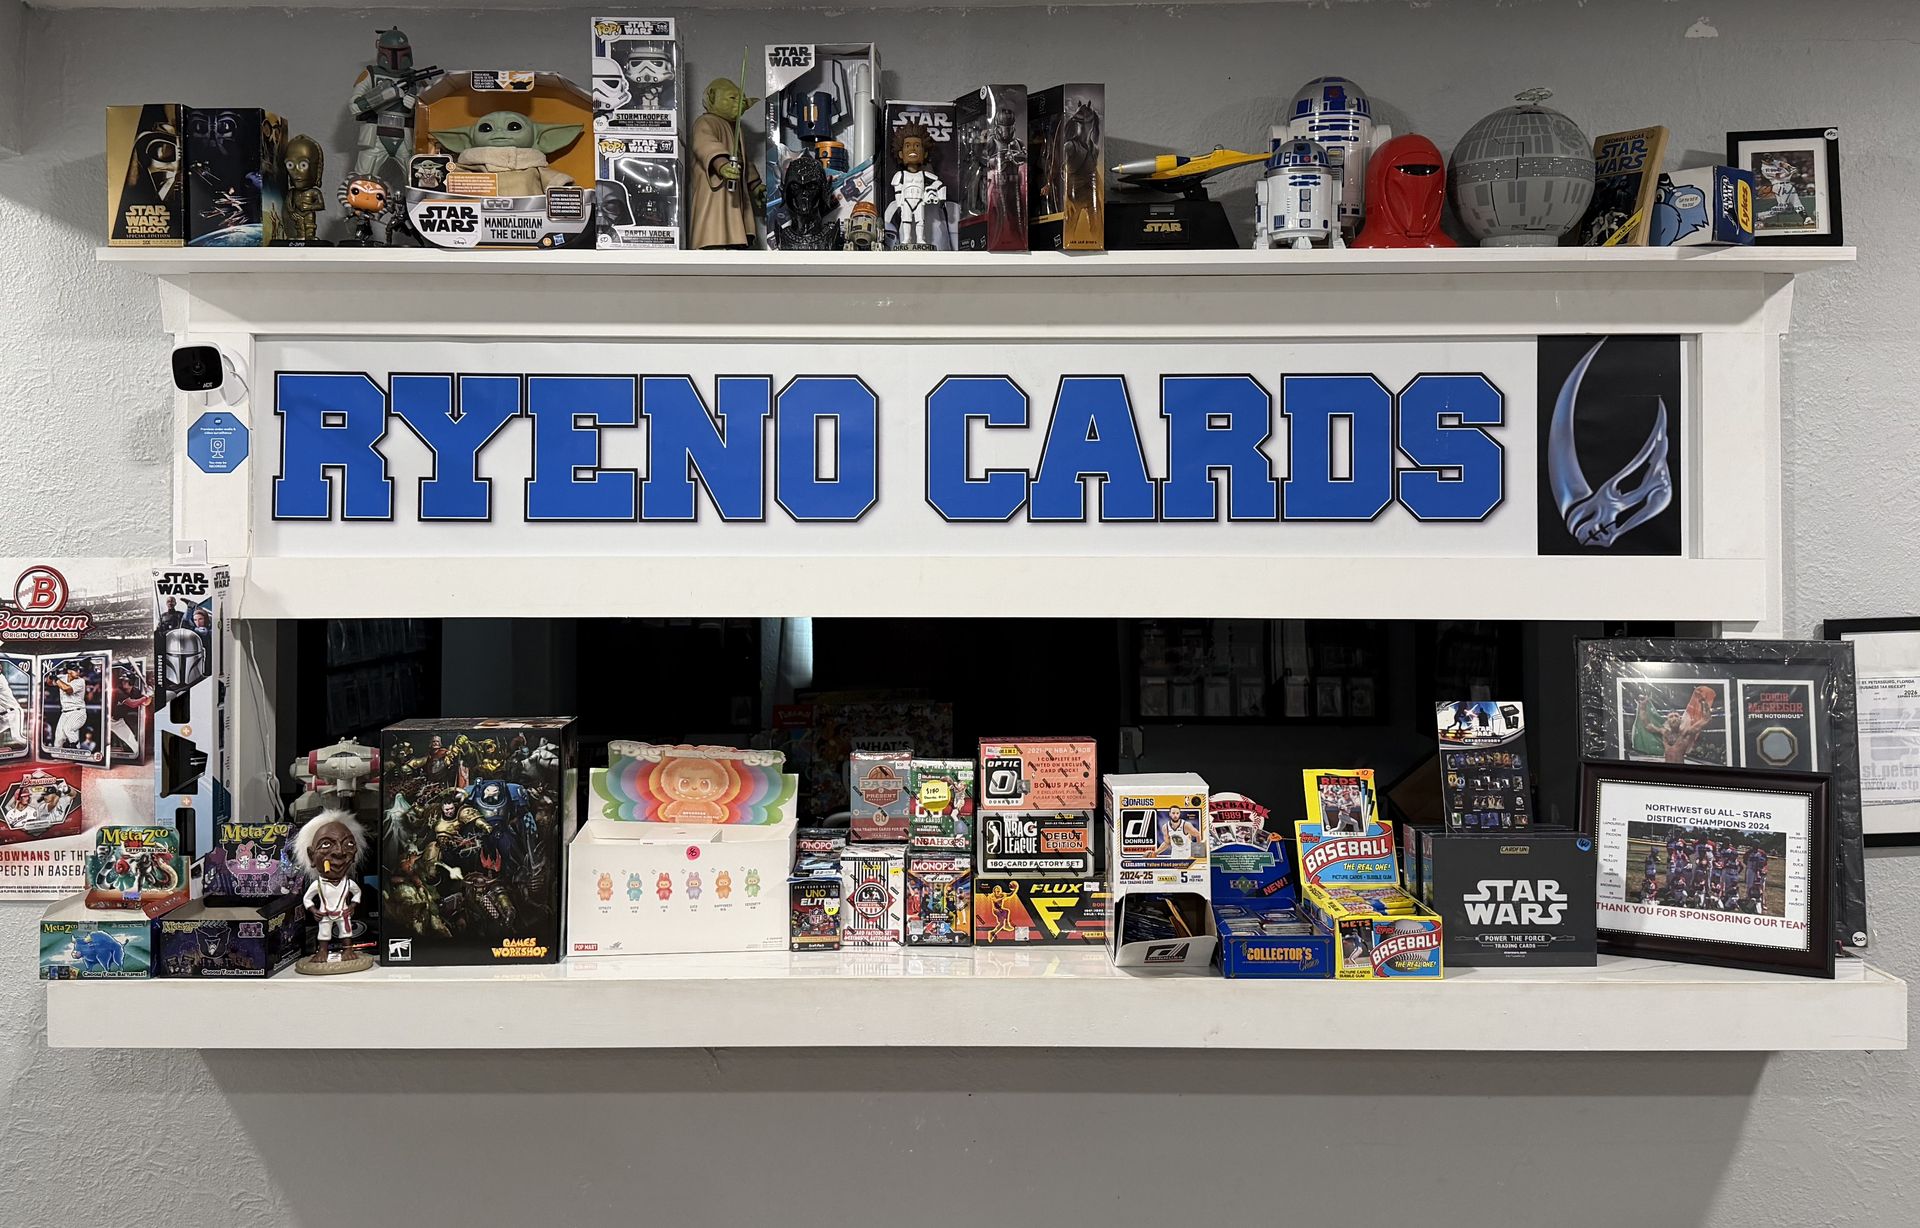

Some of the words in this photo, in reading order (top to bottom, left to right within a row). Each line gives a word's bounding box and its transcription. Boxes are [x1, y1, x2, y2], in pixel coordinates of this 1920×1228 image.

[768, 47, 811, 56] STAR
[769, 57, 812, 66] WARS
[892, 112, 952, 126] STAR
[1602, 139, 1648, 160] STAR
[1595, 154, 1646, 174] WARS
[125, 205, 170, 216] STAR
[419, 206, 478, 219] STAR
[1740, 186, 1750, 227] Lykes
[125, 216, 170, 226] WARS
[419, 220, 478, 232] WARS
[484, 218, 542, 229] MANDALORIAN
[1143, 222, 1182, 232] STAR
[490, 230, 506, 239] THE
[510, 230, 536, 239] CHILD
[272, 371, 880, 522] RYENO
[924, 372, 1505, 524] CARDS
[157, 573, 208, 583] STAR
[214, 571, 230, 580] STAR
[158, 584, 208, 595] WARS
[214, 580, 230, 589] WARS
[0, 610, 88, 630] Bowman
[1760, 693, 1789, 701] CONOR
[1748, 702, 1803, 712] McGREGOR
[1645, 804, 1702, 814] NORTHWEST
[1647, 815, 1687, 824] DISTRICT
[1690, 817, 1746, 828] CHAMPIONS
[222, 824, 289, 843] MetaZoo
[1005, 821, 1023, 837] NBA
[1024, 821, 1037, 837] G
[102, 828, 168, 846] MetaZoo
[1005, 838, 1037, 854] LEAGUE
[0, 850, 50, 862] BOWMANS
[55, 851, 66, 861] OF
[1306, 839, 1388, 873] BASEBALL
[34, 866, 43, 876] IN
[49, 866, 86, 876] BASEBA
[1120, 871, 1153, 880] 2024-25
[1181, 871, 1188, 883] 5
[1030, 884, 1082, 893] FLUX
[1263, 877, 1288, 895] NEW!
[1464, 880, 1567, 901] STAR
[1464, 903, 1567, 925] WARS
[1596, 902, 1629, 913] THANK
[1632, 906, 1654, 916] YOU
[1657, 907, 1676, 917] FOR
[1680, 910, 1750, 924] SPONSORING
[1754, 918, 1777, 927] OUR
[1780, 920, 1807, 930] TEAM
[44, 924, 78, 934] MetaZoo
[503, 938, 536, 947] GAMES
[491, 947, 547, 957] WORKSHOP
[1247, 947, 1312, 960] COLLECTOR'S
[1372, 934, 1438, 965] BASEBALL
